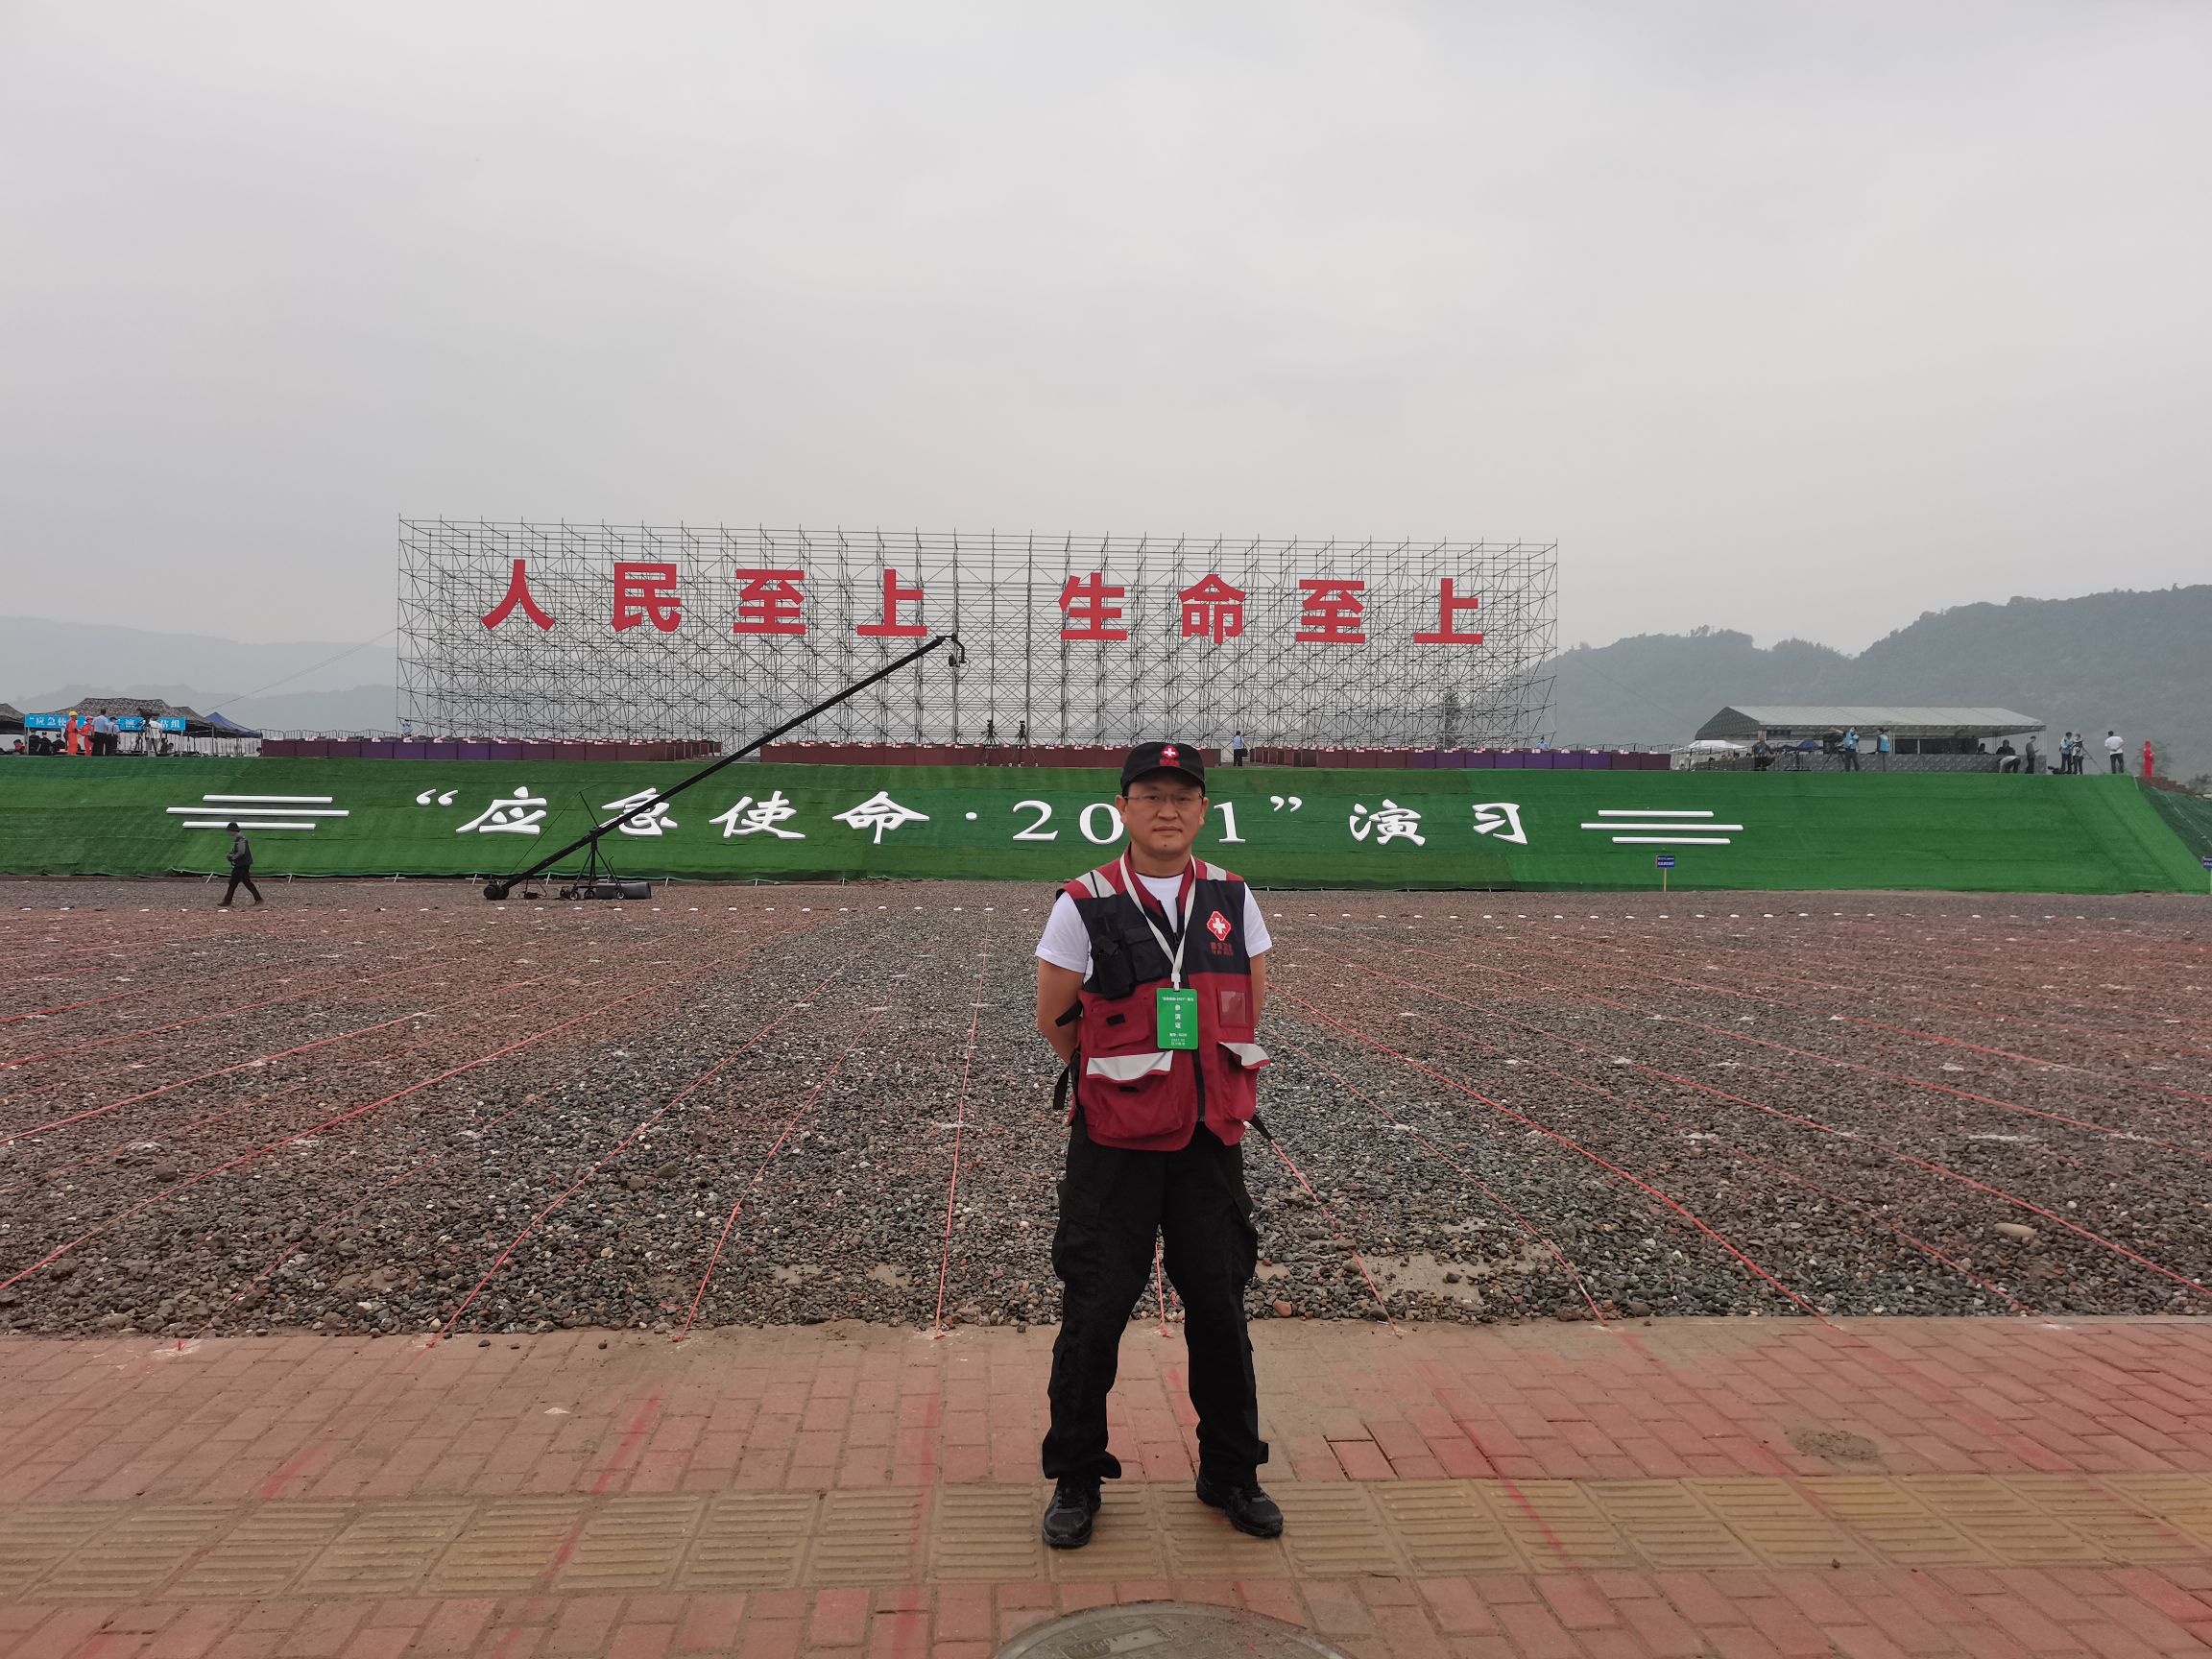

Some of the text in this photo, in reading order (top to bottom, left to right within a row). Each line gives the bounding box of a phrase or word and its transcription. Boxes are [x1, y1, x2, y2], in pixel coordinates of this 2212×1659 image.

[482, 559, 1484, 645] 人民至上 生命至上
